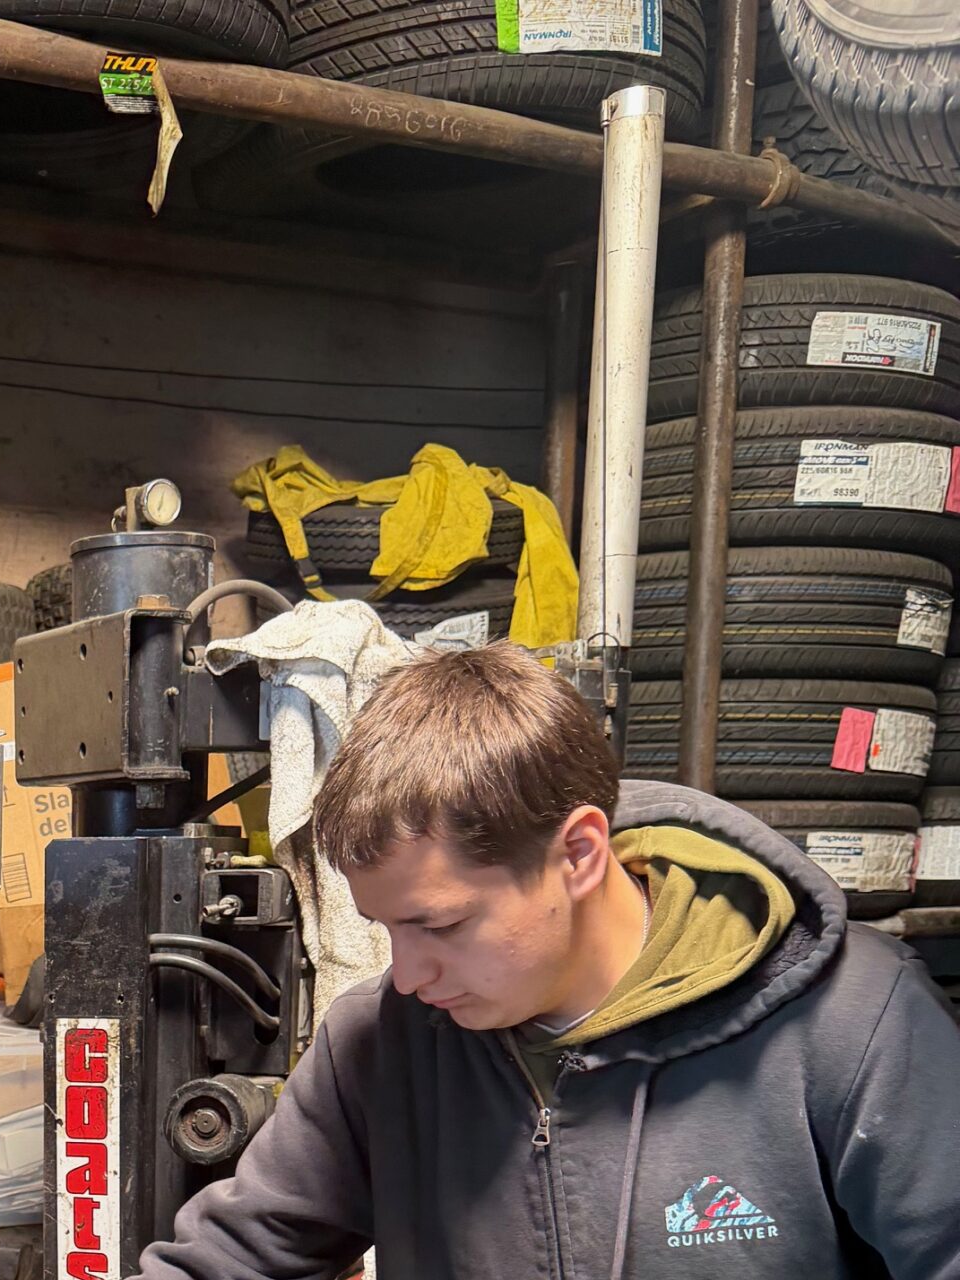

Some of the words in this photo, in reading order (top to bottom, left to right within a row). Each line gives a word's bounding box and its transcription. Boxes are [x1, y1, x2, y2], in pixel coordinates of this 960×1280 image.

[523, 29, 572, 40] IRONMAN
[101, 78, 116, 89] ST
[814, 442, 868, 452] IRONMAN
[34, 792, 70, 814] Sla
[667, 1225, 779, 1248] QUIKSILVER
